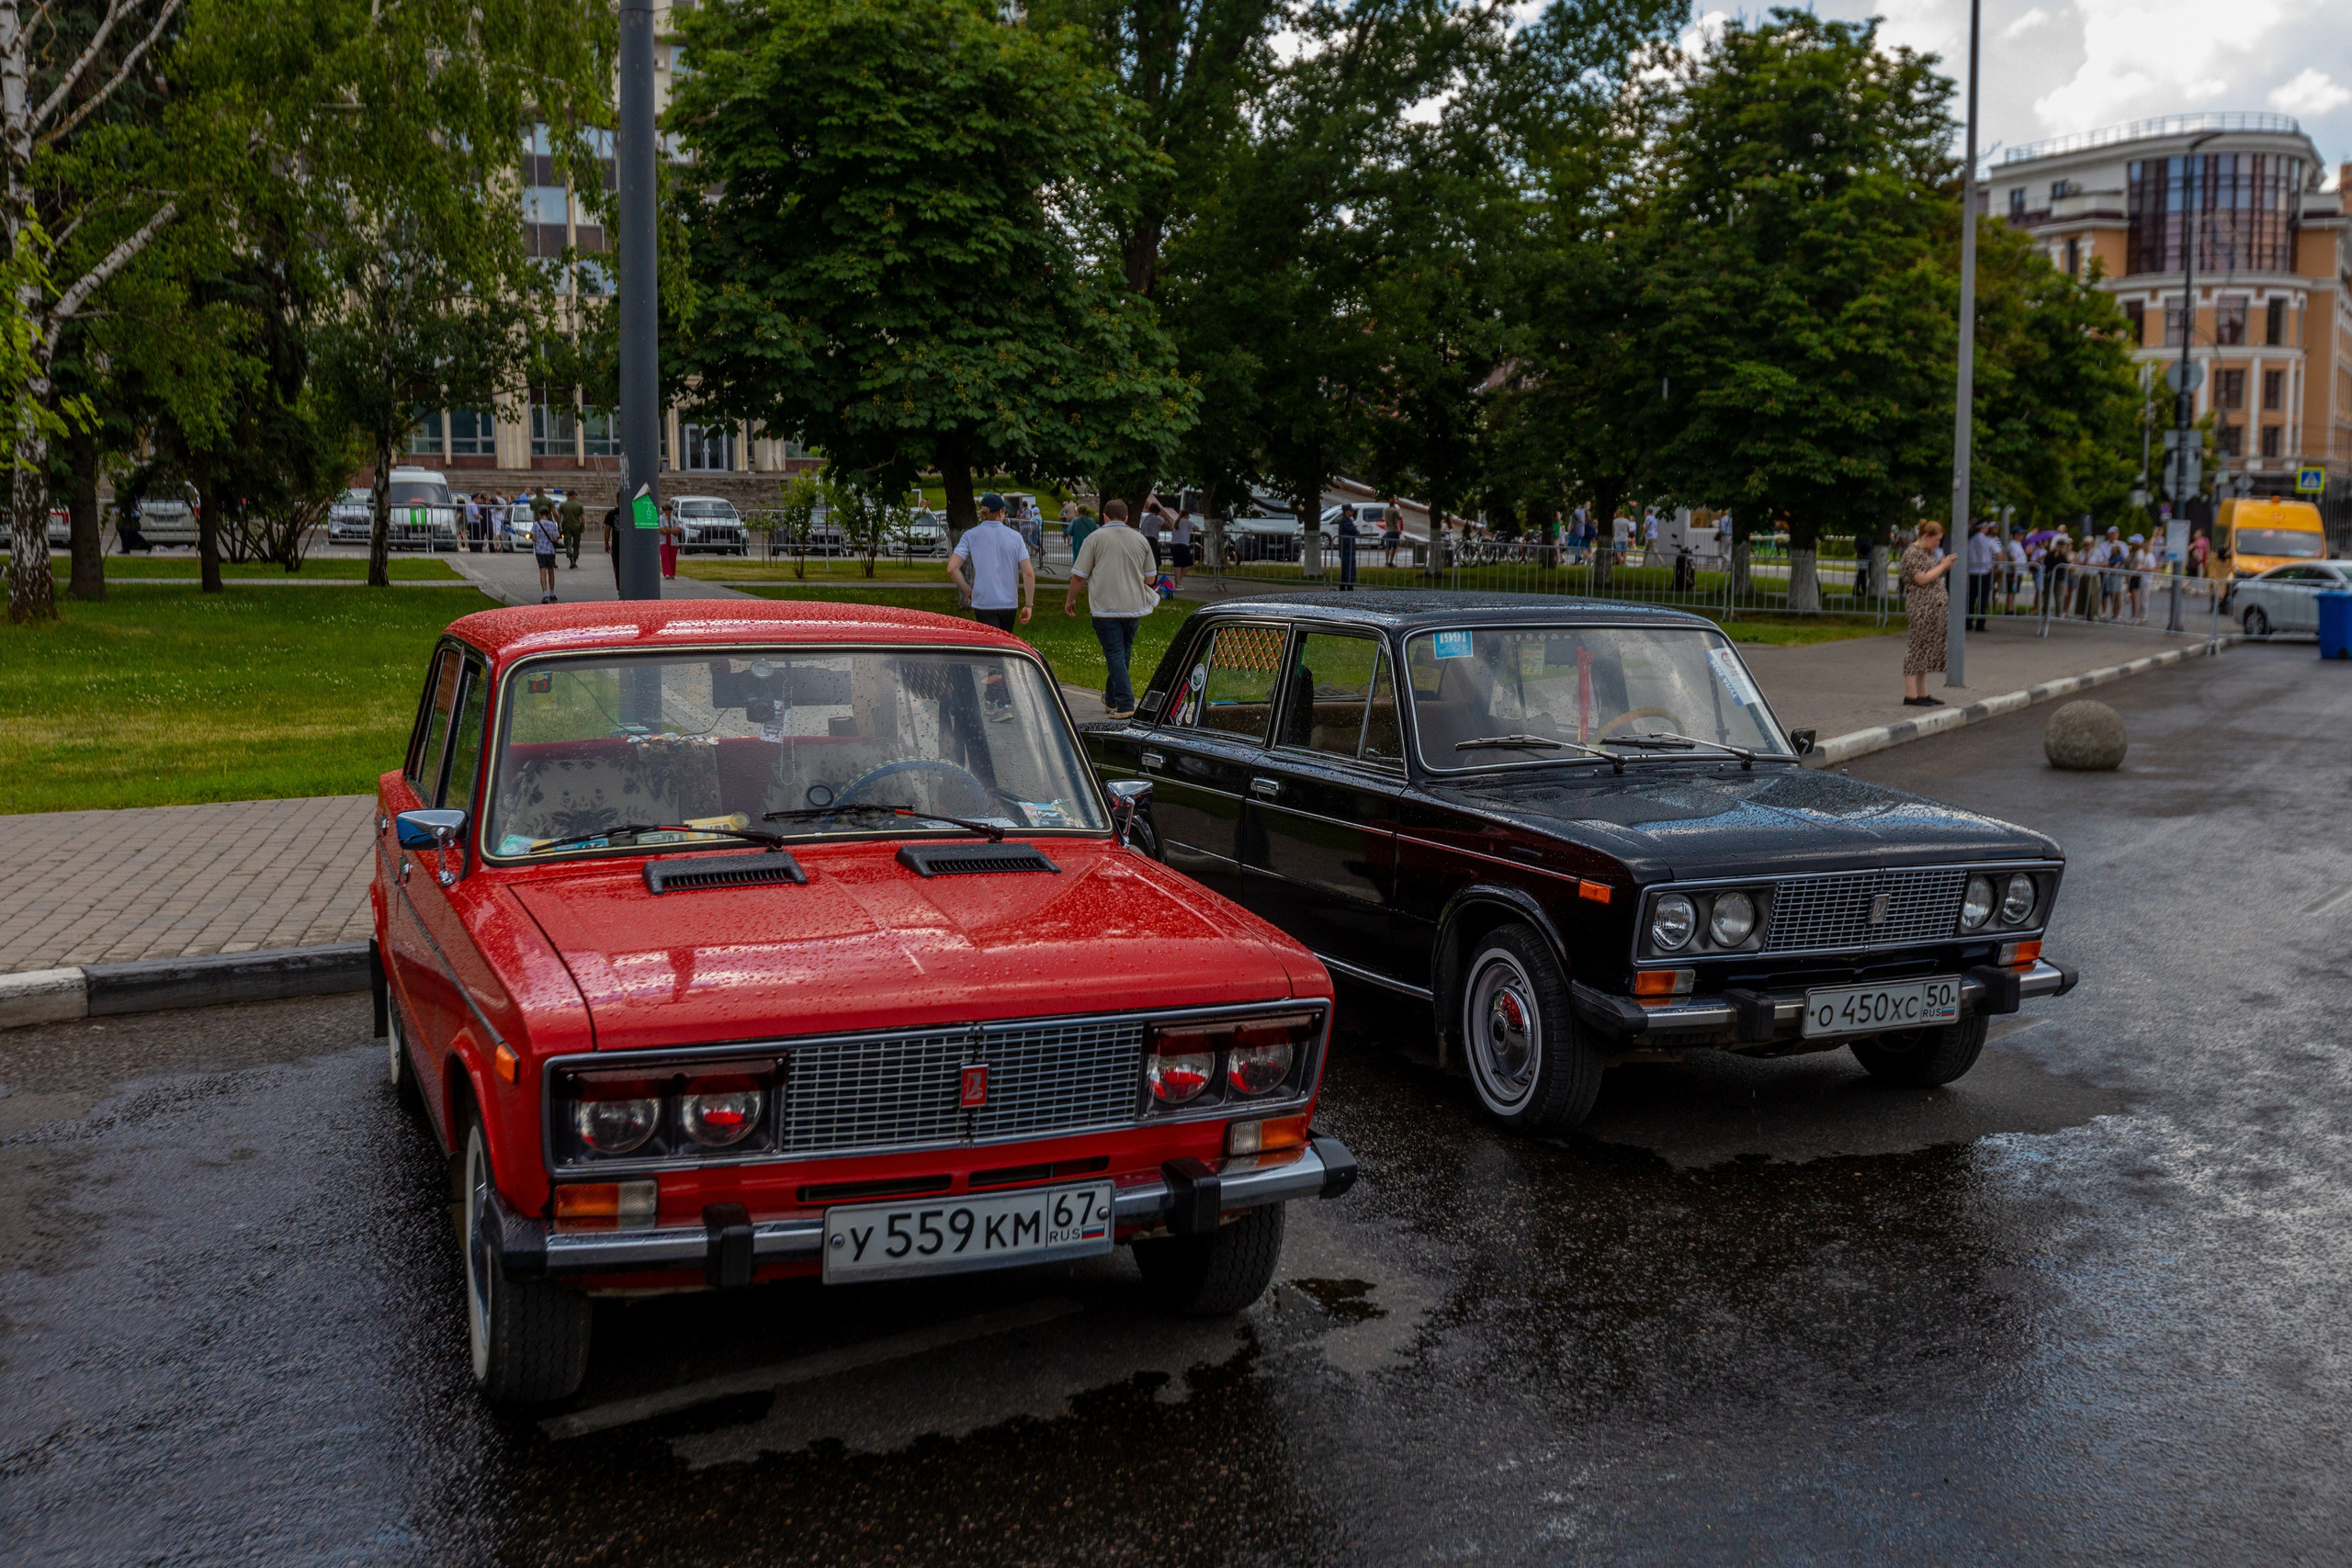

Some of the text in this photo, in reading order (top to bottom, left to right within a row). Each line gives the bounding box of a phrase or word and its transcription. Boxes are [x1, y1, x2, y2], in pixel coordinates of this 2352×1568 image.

[1439, 631, 1467, 644] 1991
[1723, 677, 1737, 698] ТУЛА
[1926, 984, 1951, 1007] 50
[1922, 1008, 1941, 1018] RUS
[1053, 1190, 1096, 1228] 67
[1049, 1227, 1081, 1243] RUS
